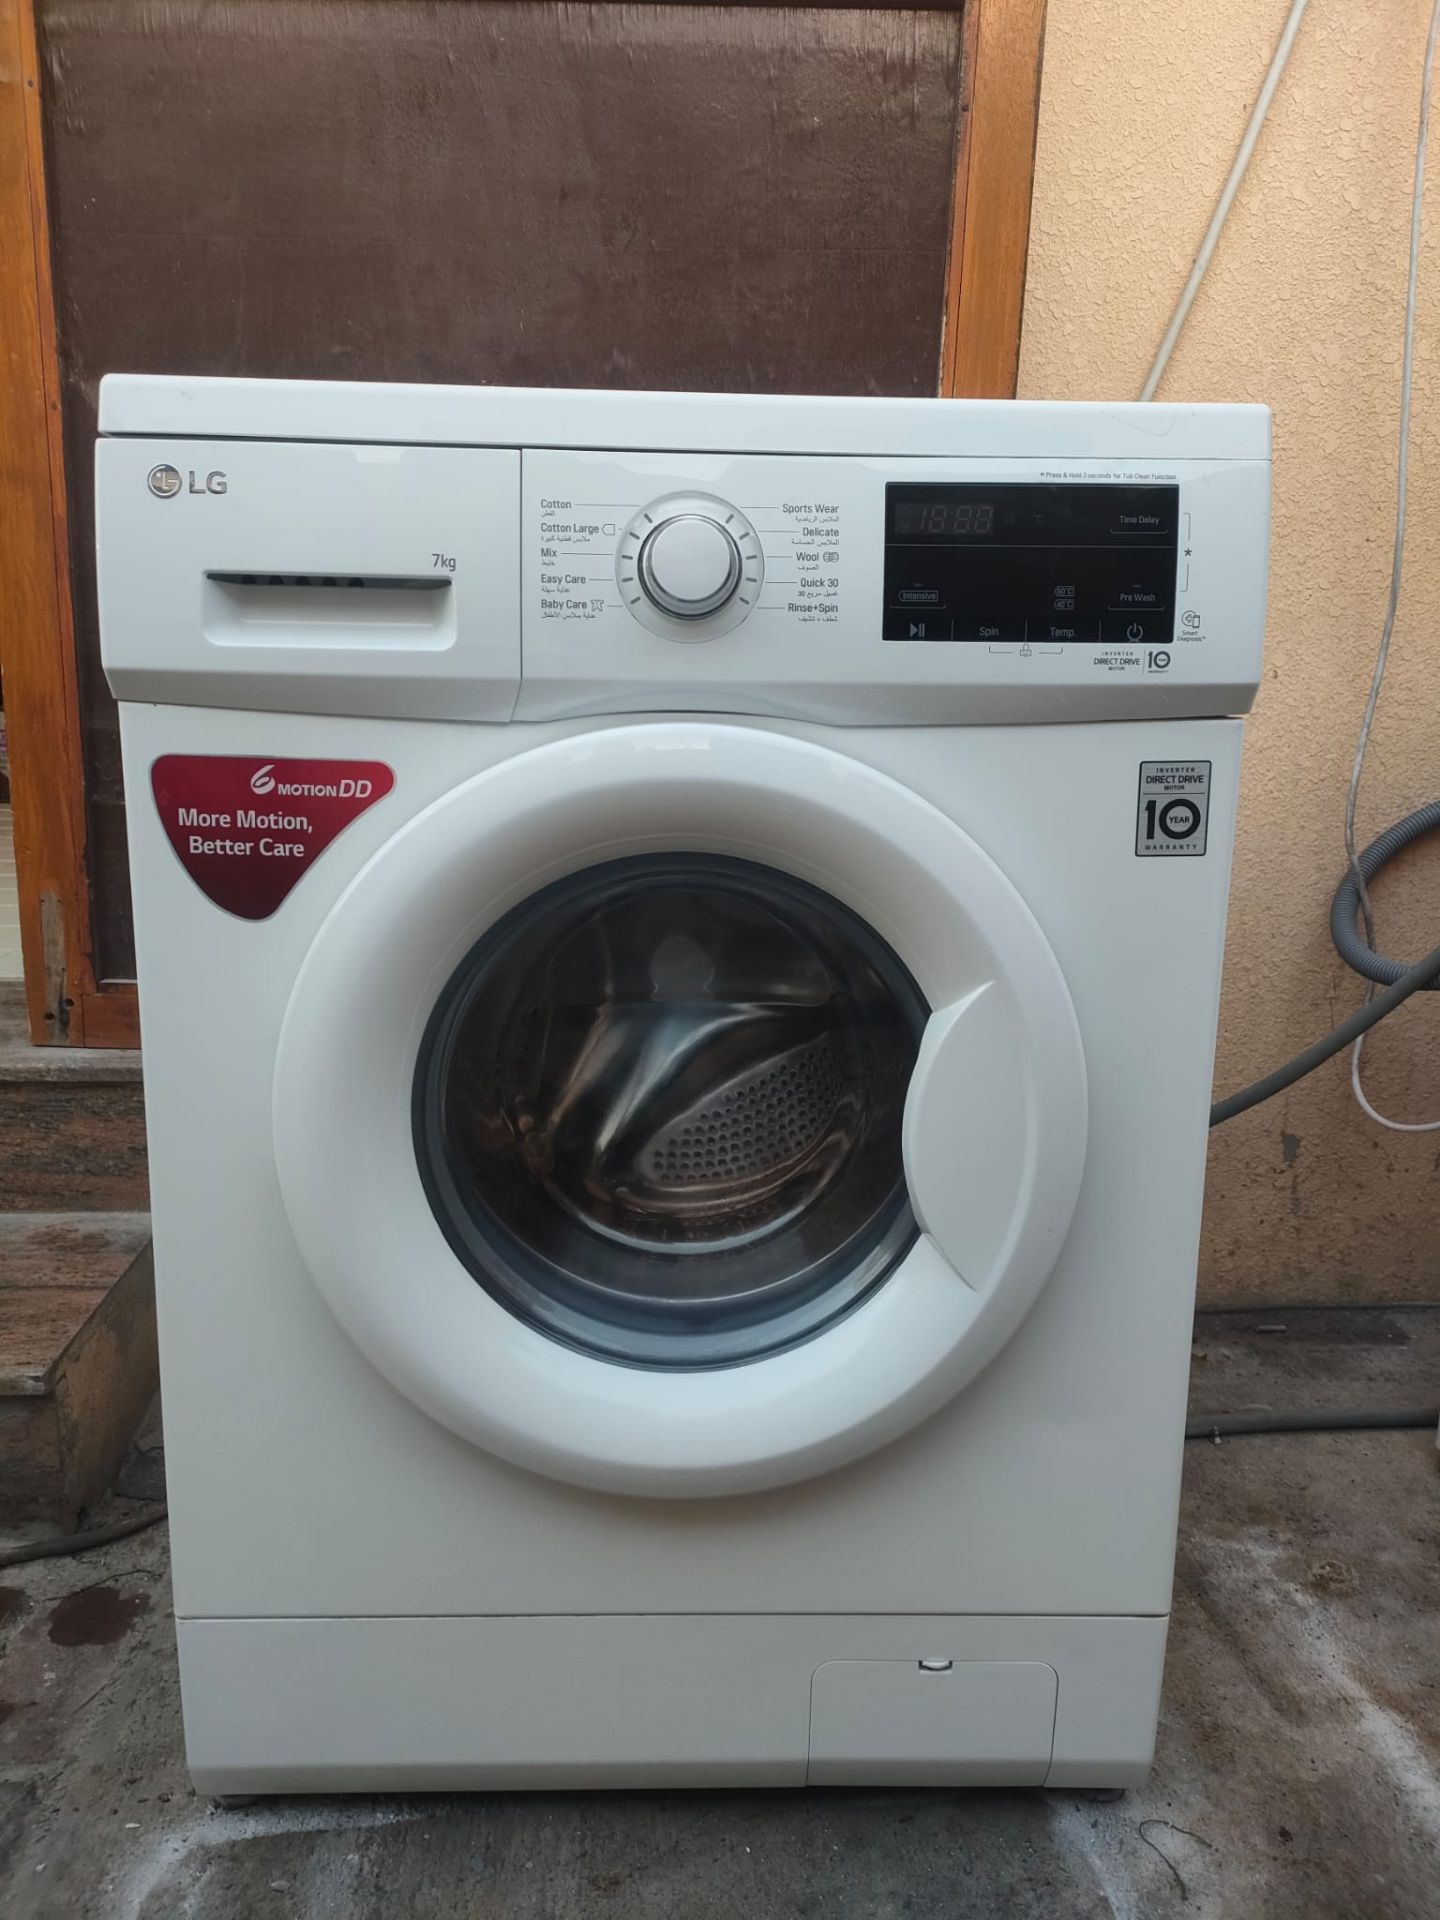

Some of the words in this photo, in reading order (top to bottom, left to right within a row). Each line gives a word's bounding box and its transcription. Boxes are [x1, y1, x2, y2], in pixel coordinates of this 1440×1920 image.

[188, 470, 228, 495] LG
[540, 499, 572, 509] Cotton
[782, 503, 813, 514] Sports
[814, 504, 840, 514] Wear
[1119, 515, 1137, 525] Time
[1138, 516, 1160, 527] Delay
[540, 522, 572, 533] Cotton
[573, 523, 600, 535] Large
[802, 526, 840, 537] Delicate
[540, 547, 558, 557] Mix
[796, 552, 820, 561] Wool
[431, 553, 457, 572] 7kg
[540, 574, 563, 585] Easy
[564, 574, 587, 585] Care
[800, 577, 826, 588] Quick
[827, 578, 839, 588] 30
[902, 591, 937, 601] Intensive
[1120, 593, 1133, 602] Pre
[1134, 593, 1156, 602] Wash
[540, 600, 565, 612] Baby
[566, 600, 588, 610] Care
[788, 603, 839, 614] Rinse+Spin
[979, 626, 999, 638] Spin
[1050, 626, 1077, 638] Temp.
[1093, 657, 1119, 666] DIRECT
[1119, 657, 1141, 666] DRIVE
[1145, 775, 1177, 784] DIRECT
[1178, 774, 1205, 784] DRIVE
[178, 807, 231, 828] More
[236, 809, 313, 834] Motion,
[1144, 798, 1202, 840] 10
[1168, 815, 1191, 824] YEAR
[189, 835, 254, 856] Better
[259, 838, 305, 857] Care
